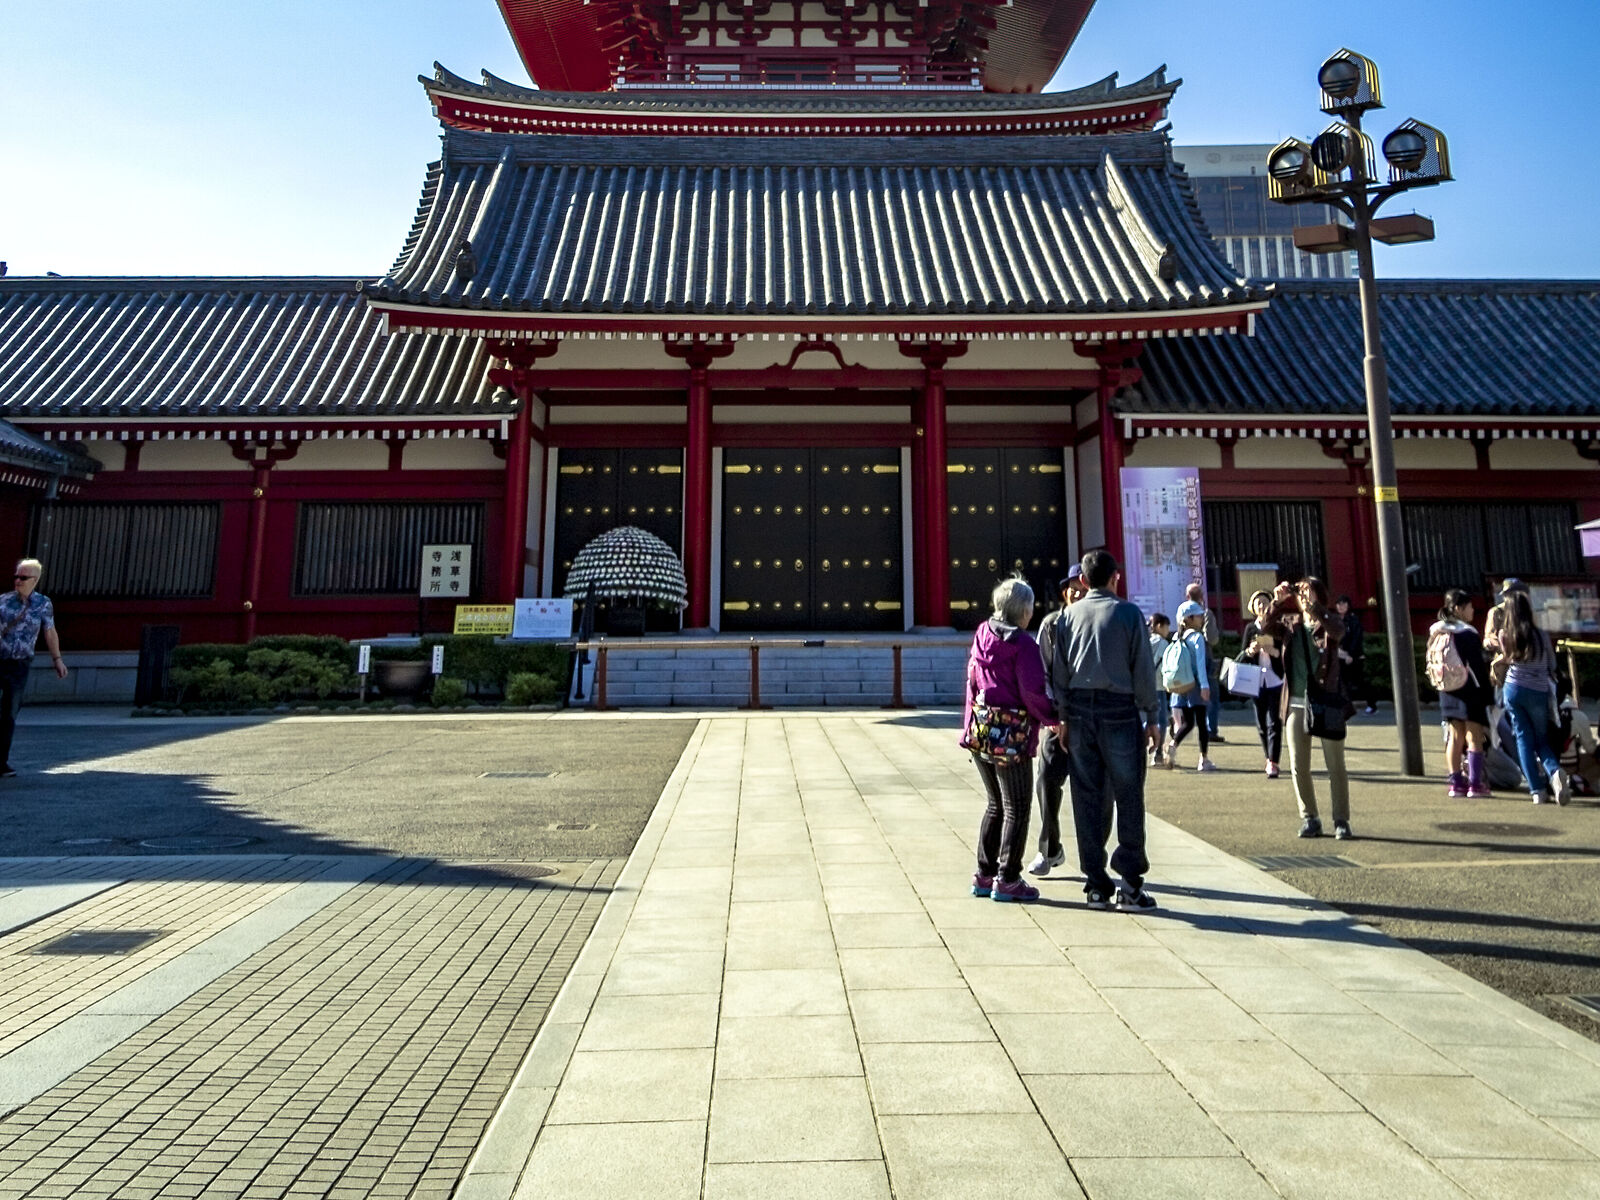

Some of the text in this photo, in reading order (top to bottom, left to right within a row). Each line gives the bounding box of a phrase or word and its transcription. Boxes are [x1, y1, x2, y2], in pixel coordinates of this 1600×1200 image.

[430, 551, 442, 592] 寺務所
[450, 550, 462, 592] 浅草寺
